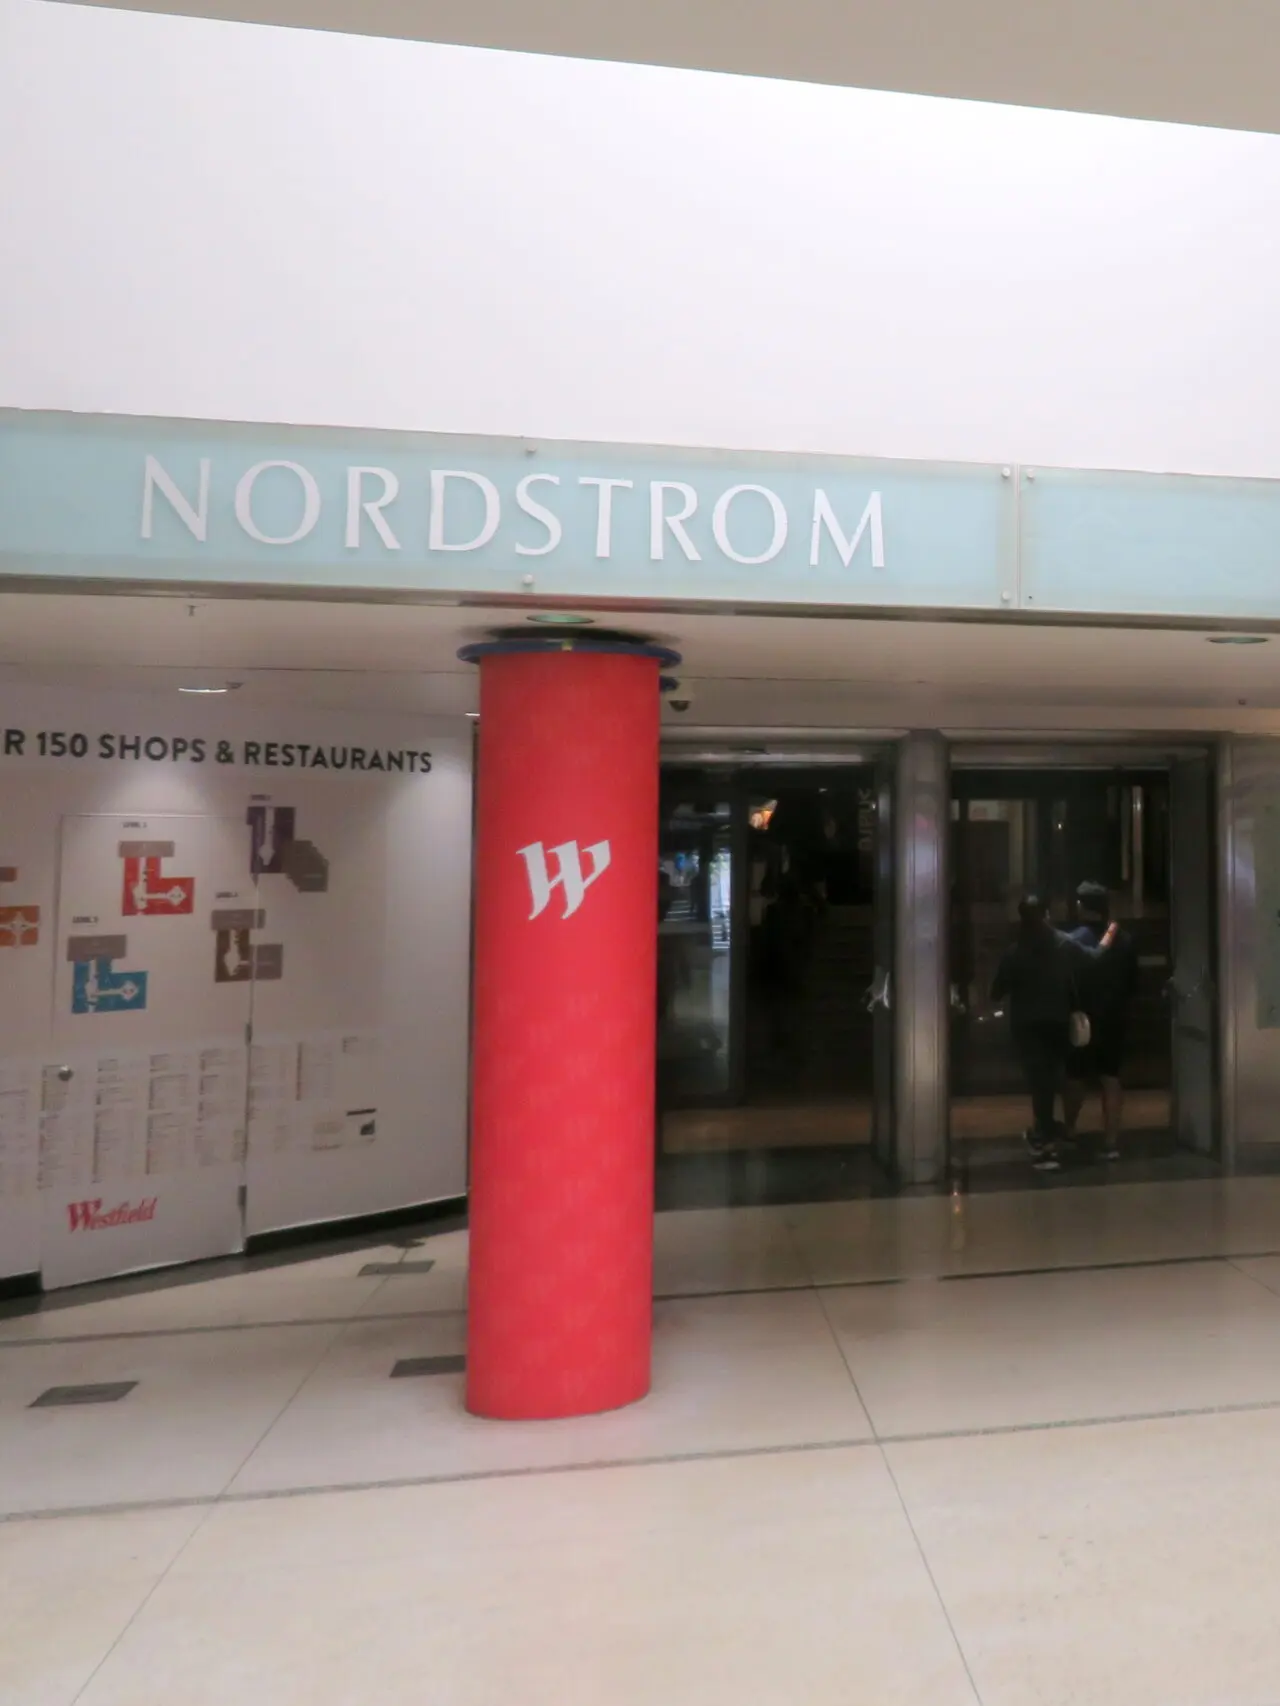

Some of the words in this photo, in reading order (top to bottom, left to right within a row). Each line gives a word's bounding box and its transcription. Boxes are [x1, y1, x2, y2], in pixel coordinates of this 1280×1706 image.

[139, 454, 885, 570] NORDSTROM
[36, 731, 89, 758] 150
[98, 733, 207, 763] SHOPS
[214, 740, 235, 764] &
[243, 741, 433, 774] RESTAURANTS
[67, 1196, 158, 1235] Westfield
